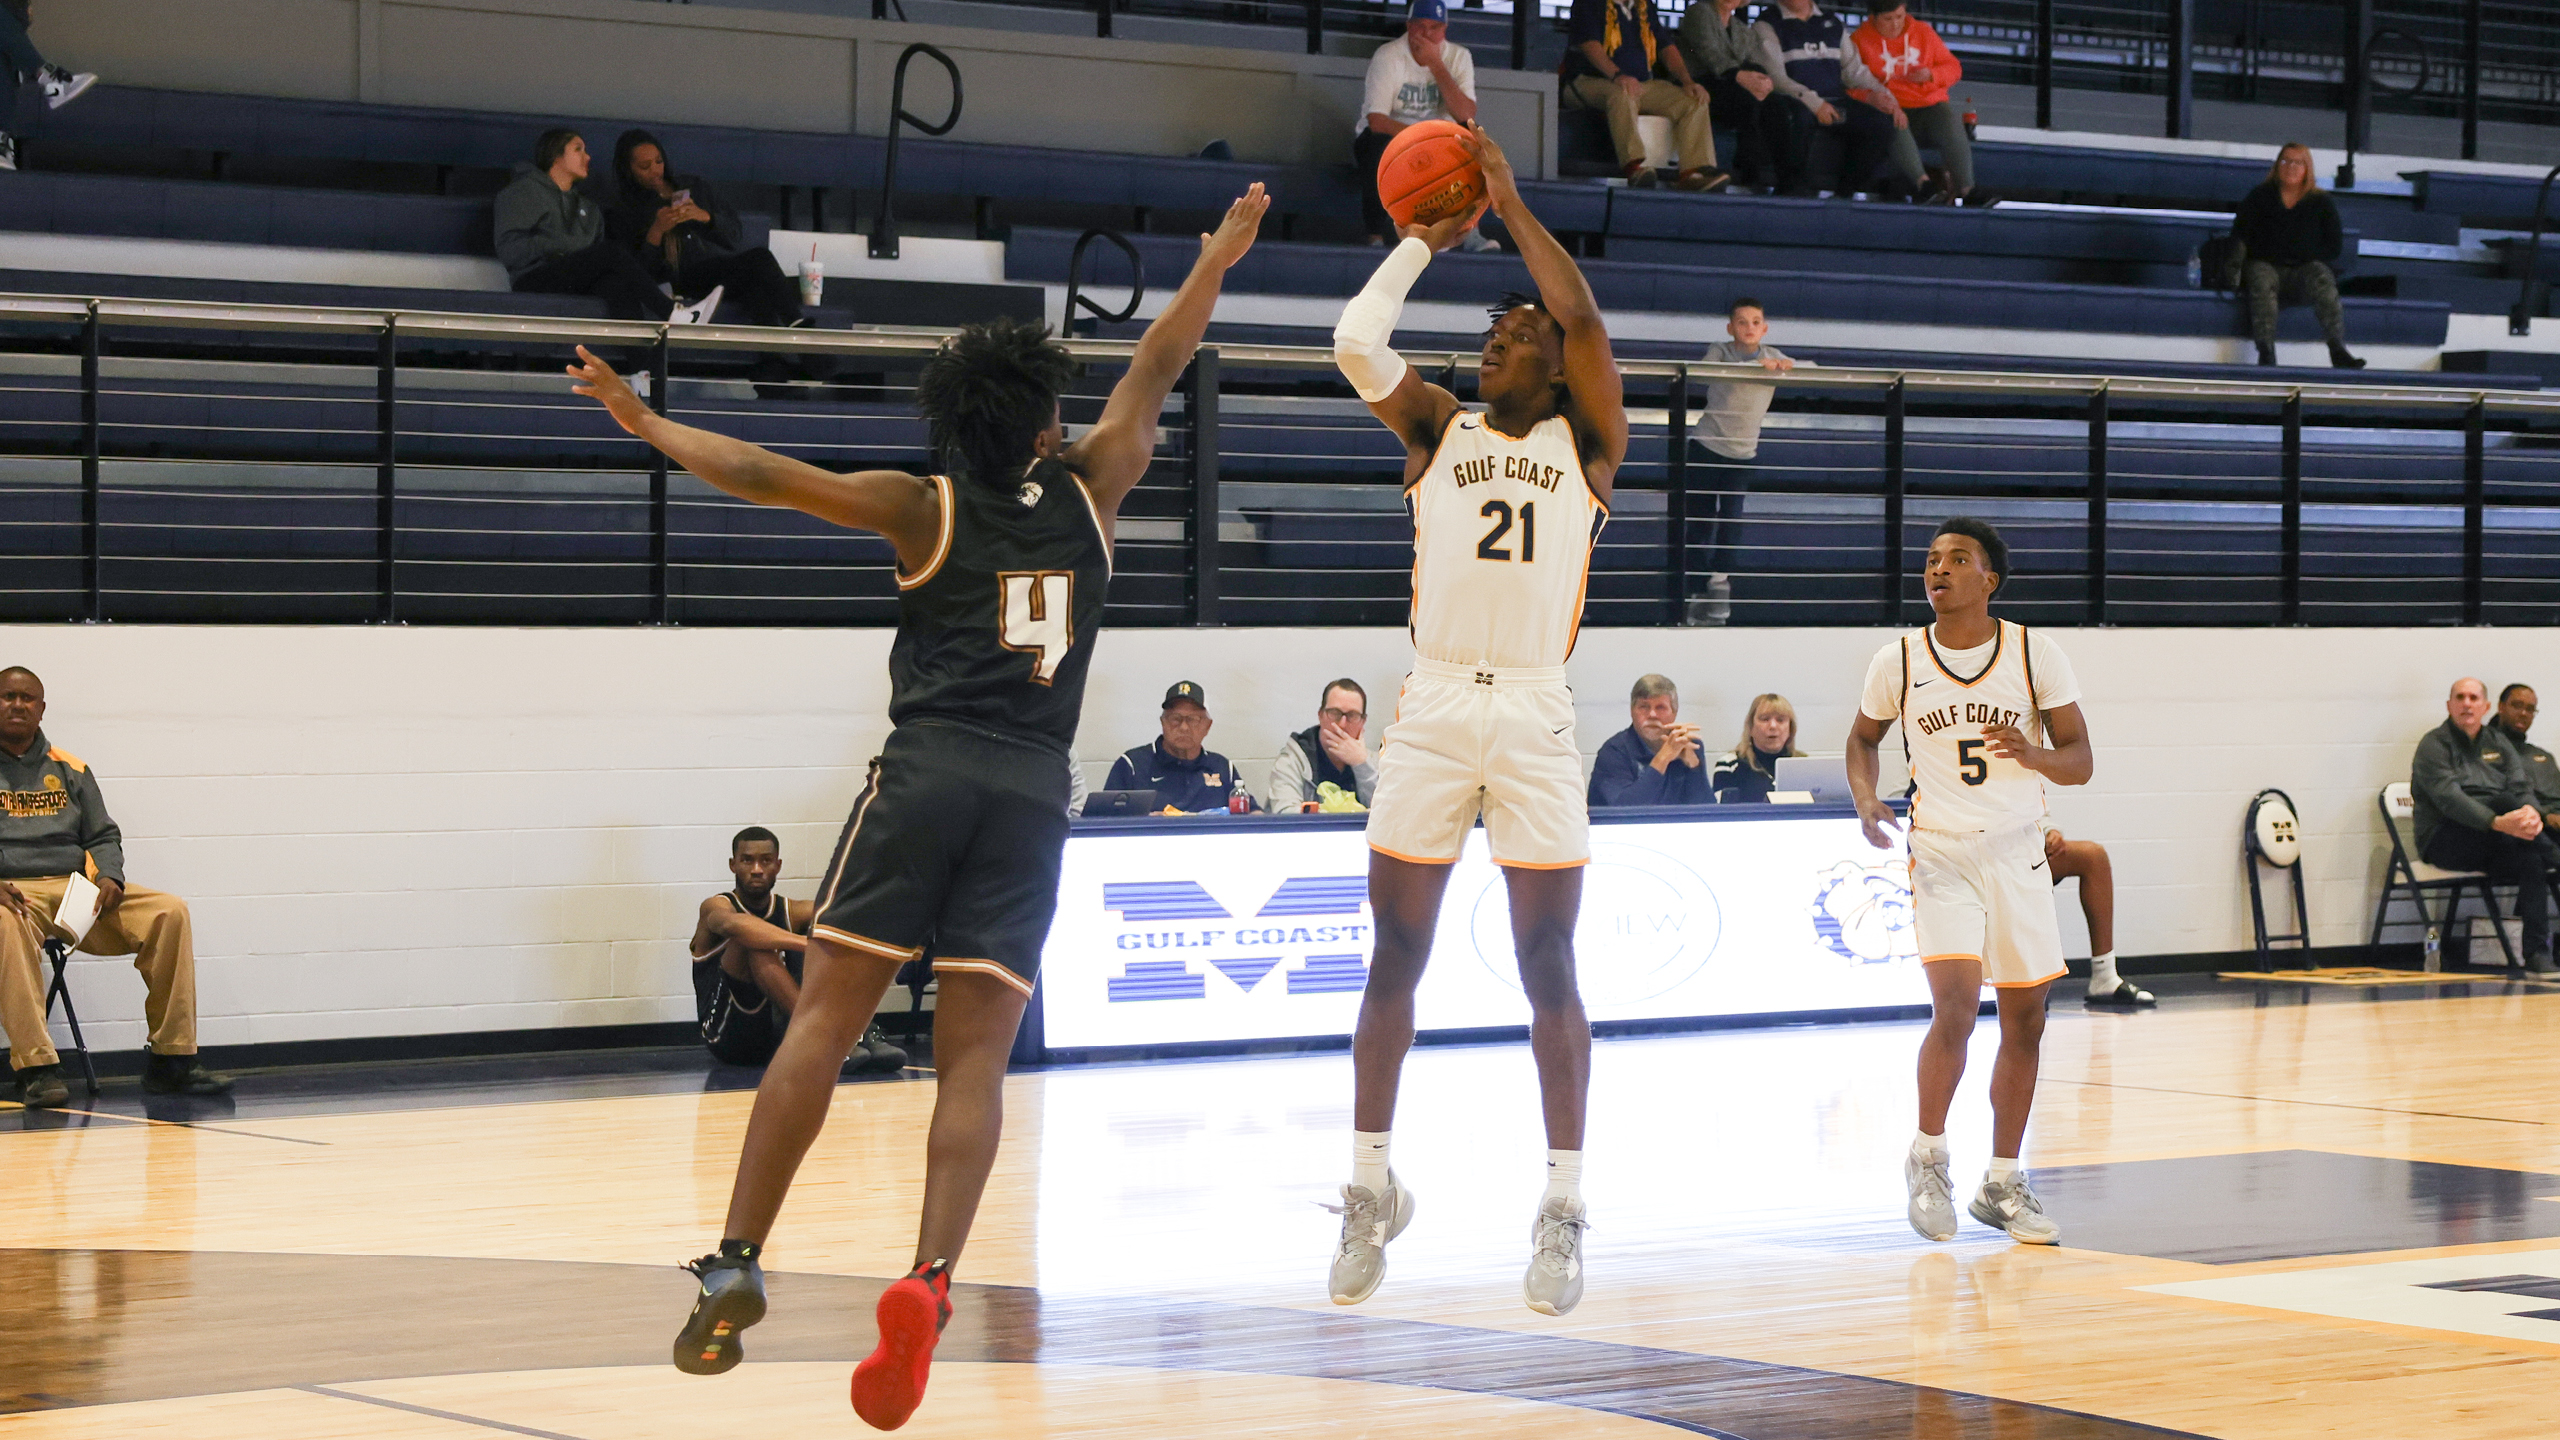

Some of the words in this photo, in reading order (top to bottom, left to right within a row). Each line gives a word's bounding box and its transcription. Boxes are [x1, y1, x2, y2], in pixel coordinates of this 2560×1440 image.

[1453, 455, 1497, 489] GULF
[1504, 456, 1565, 494] COAST
[1475, 498, 1536, 564] 21
[996, 570, 1075, 688] 4
[1917, 704, 1959, 736] GULF
[1966, 702, 2022, 728] COAST
[1957, 738, 1988, 787] 5
[1116, 930, 1226, 951] GULF
[1235, 925, 1369, 946] COAST
